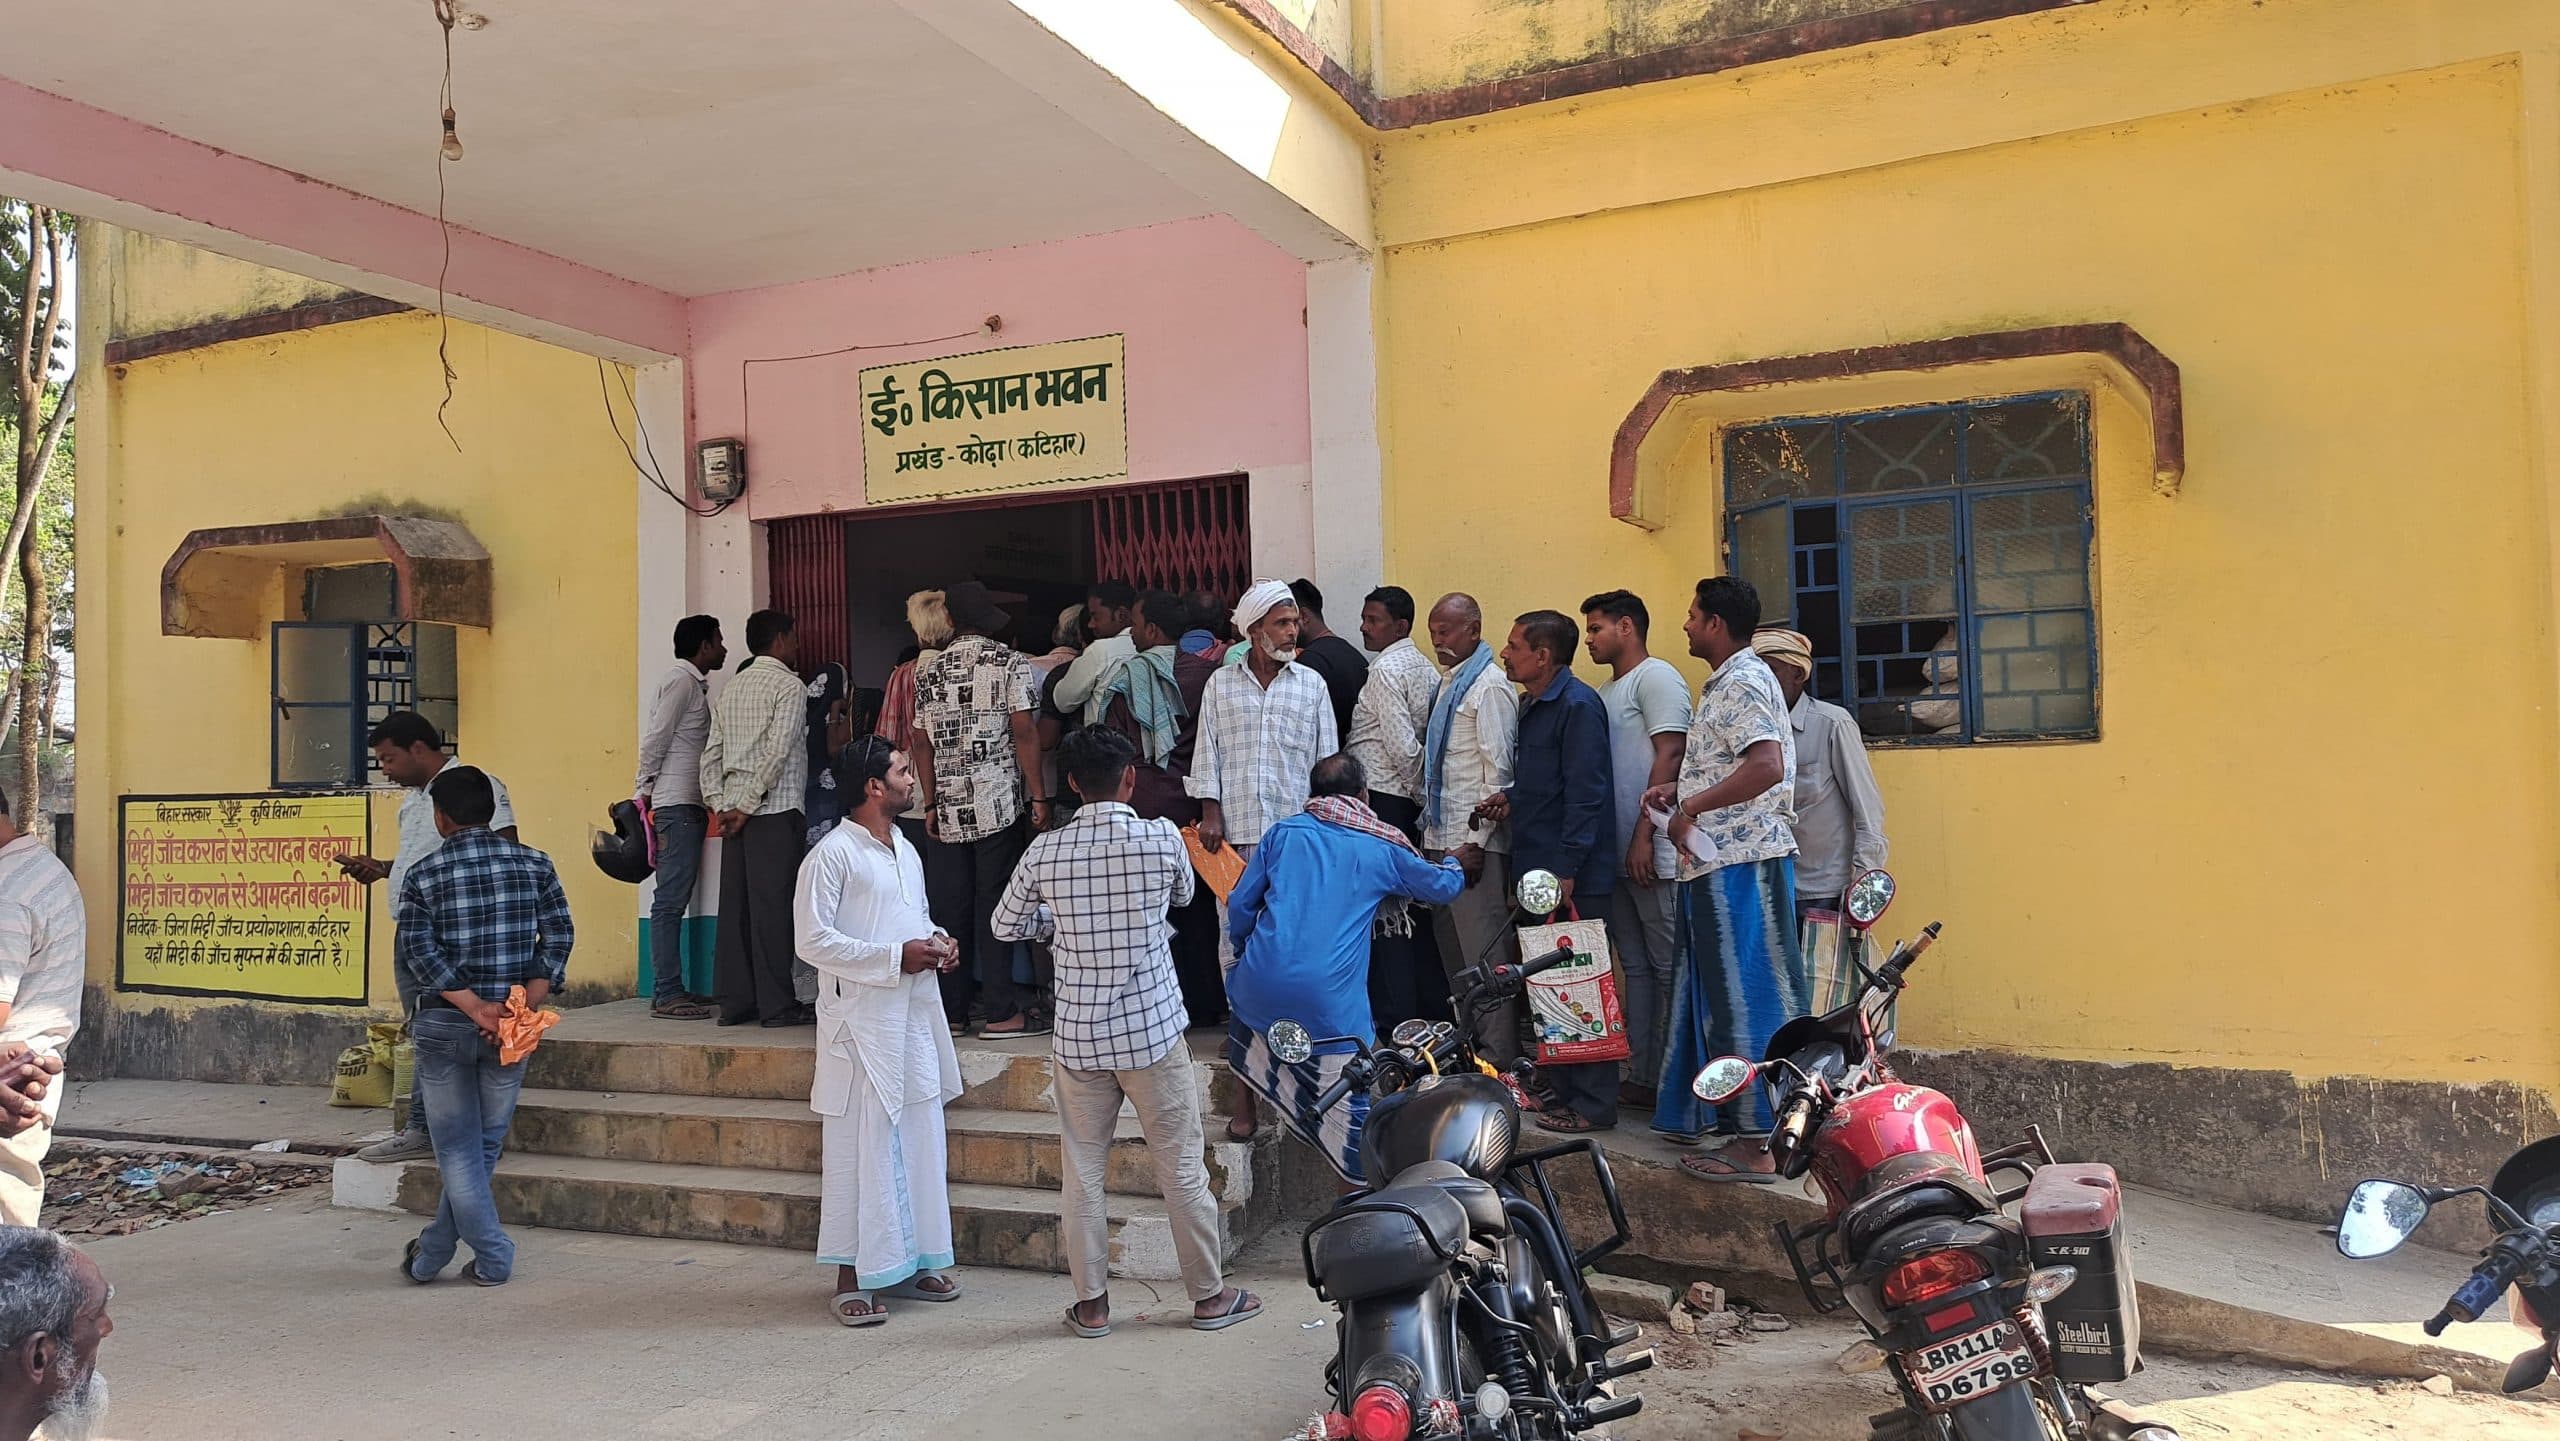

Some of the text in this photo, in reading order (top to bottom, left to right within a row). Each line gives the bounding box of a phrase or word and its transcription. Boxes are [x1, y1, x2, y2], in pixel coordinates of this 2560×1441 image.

[918, 369, 1033, 422] किसान
[1034, 363, 1113, 407] भवन
[156, 800, 303, 826] बिहार सरकार कृषि विभाग
[127, 827, 155, 872] मिट्टी
[156, 829, 186, 864] जाँच
[187, 828, 230, 864] कराने
[231, 828, 248, 864] से
[248, 837, 307, 867] उत्पादन
[127, 872, 155, 915] मिट्टी
[157, 873, 186, 908] जाँच
[187, 872, 230, 909] कराने
[231, 872, 248, 909] से
[248, 870, 307, 912] आमदनी
[163, 912, 190, 936] जिला
[190, 911, 216, 939] मिट्टी
[216, 914, 245, 937] जाँच
[307, 914, 350, 942] कटिहार
[144, 941, 164, 970] यहाँ
[166, 940, 190, 966] मिट्टी
[190, 940, 205, 965] की
[207, 940, 232, 965] जाँच
[265, 942, 278, 965] में
[278, 941, 293, 966] की
[293, 939, 327, 967] जाती
[1926, 1328, 2004, 1370] BR11A
[2057, 1321, 2111, 1345] Steelbird
[1928, 1355, 2034, 1402] D6798
